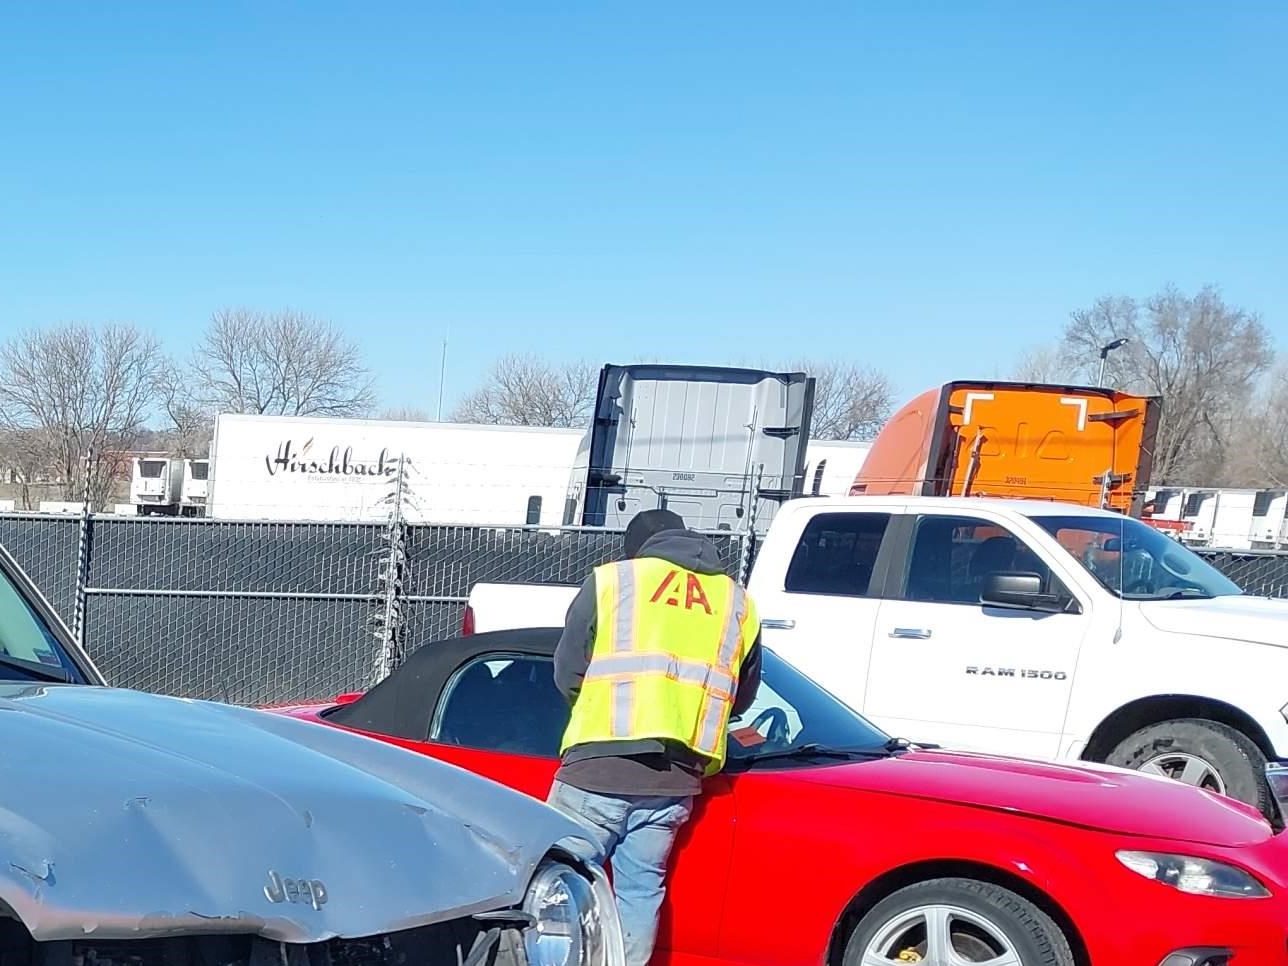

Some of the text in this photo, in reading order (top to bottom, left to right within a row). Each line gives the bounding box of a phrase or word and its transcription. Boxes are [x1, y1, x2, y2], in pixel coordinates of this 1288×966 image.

[965, 666, 1067, 680] RAM 1500
[263, 869, 329, 911] Jeep
